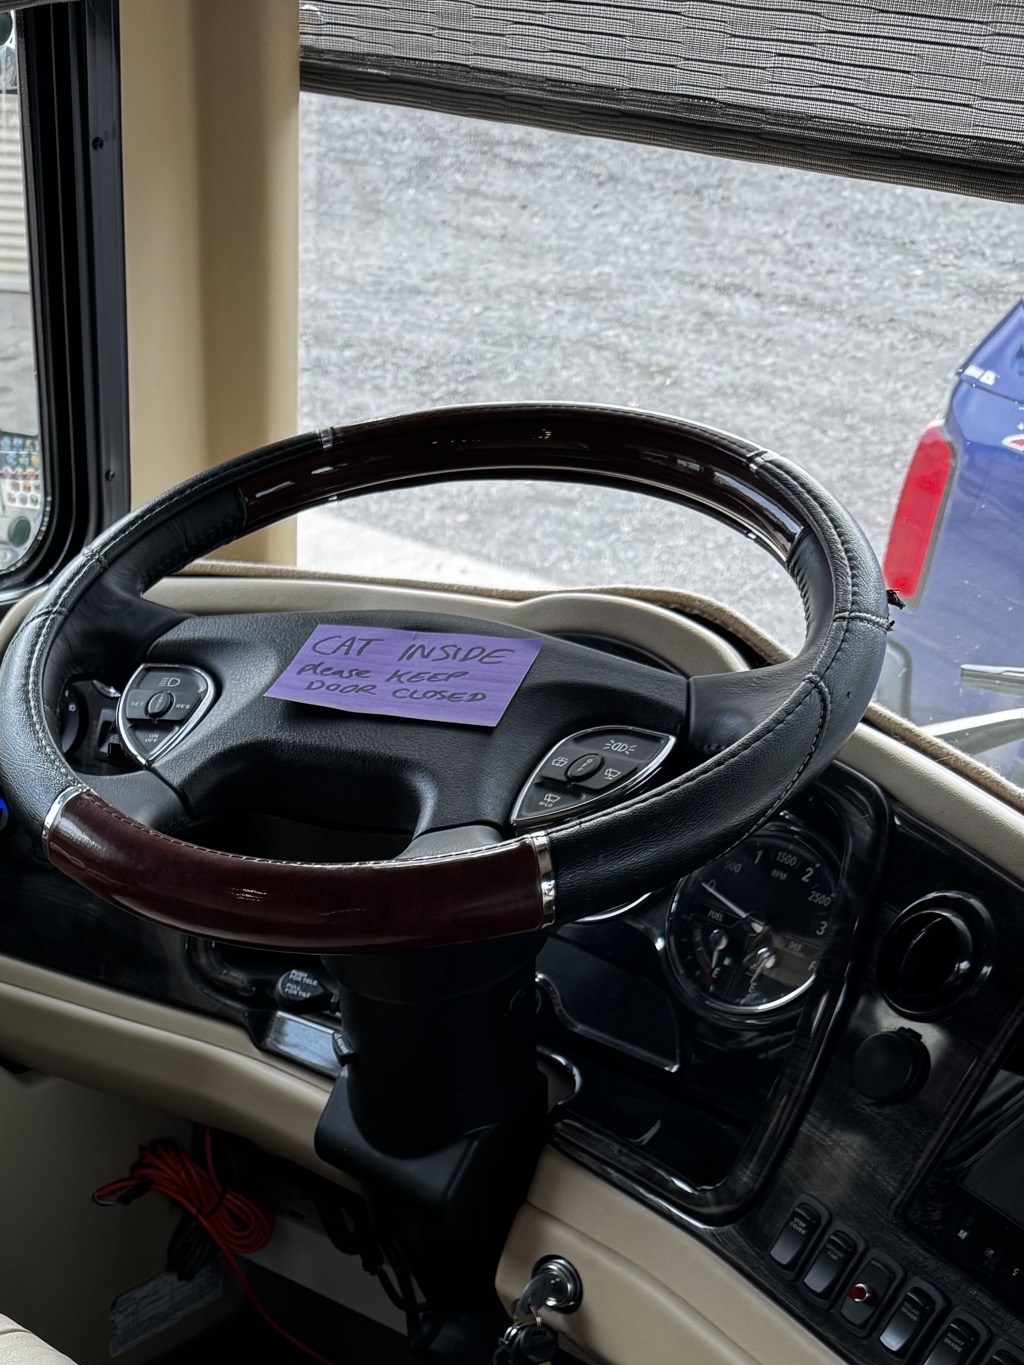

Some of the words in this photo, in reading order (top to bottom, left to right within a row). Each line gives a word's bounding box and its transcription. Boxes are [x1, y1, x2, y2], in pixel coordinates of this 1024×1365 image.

[311, 635, 385, 657] CAT
[397, 643, 516, 665] INSIDE
[385, 669, 469, 684] KEEP
[305, 679, 377, 695] DOOR
[391, 687, 487, 703] CLOSED
[755, 851, 763, 864] 1
[777, 851, 797, 867] 1500
[724, 861, 742, 873] 500
[771, 869, 788, 880] RPM
[801, 867, 814, 883] 2
[808, 890, 831, 907] 2500
[708, 910, 724, 922] FUEL
[816, 921, 828, 936] 3
[789, 941, 802, 951] DEF
[712, 968, 720, 979] E
